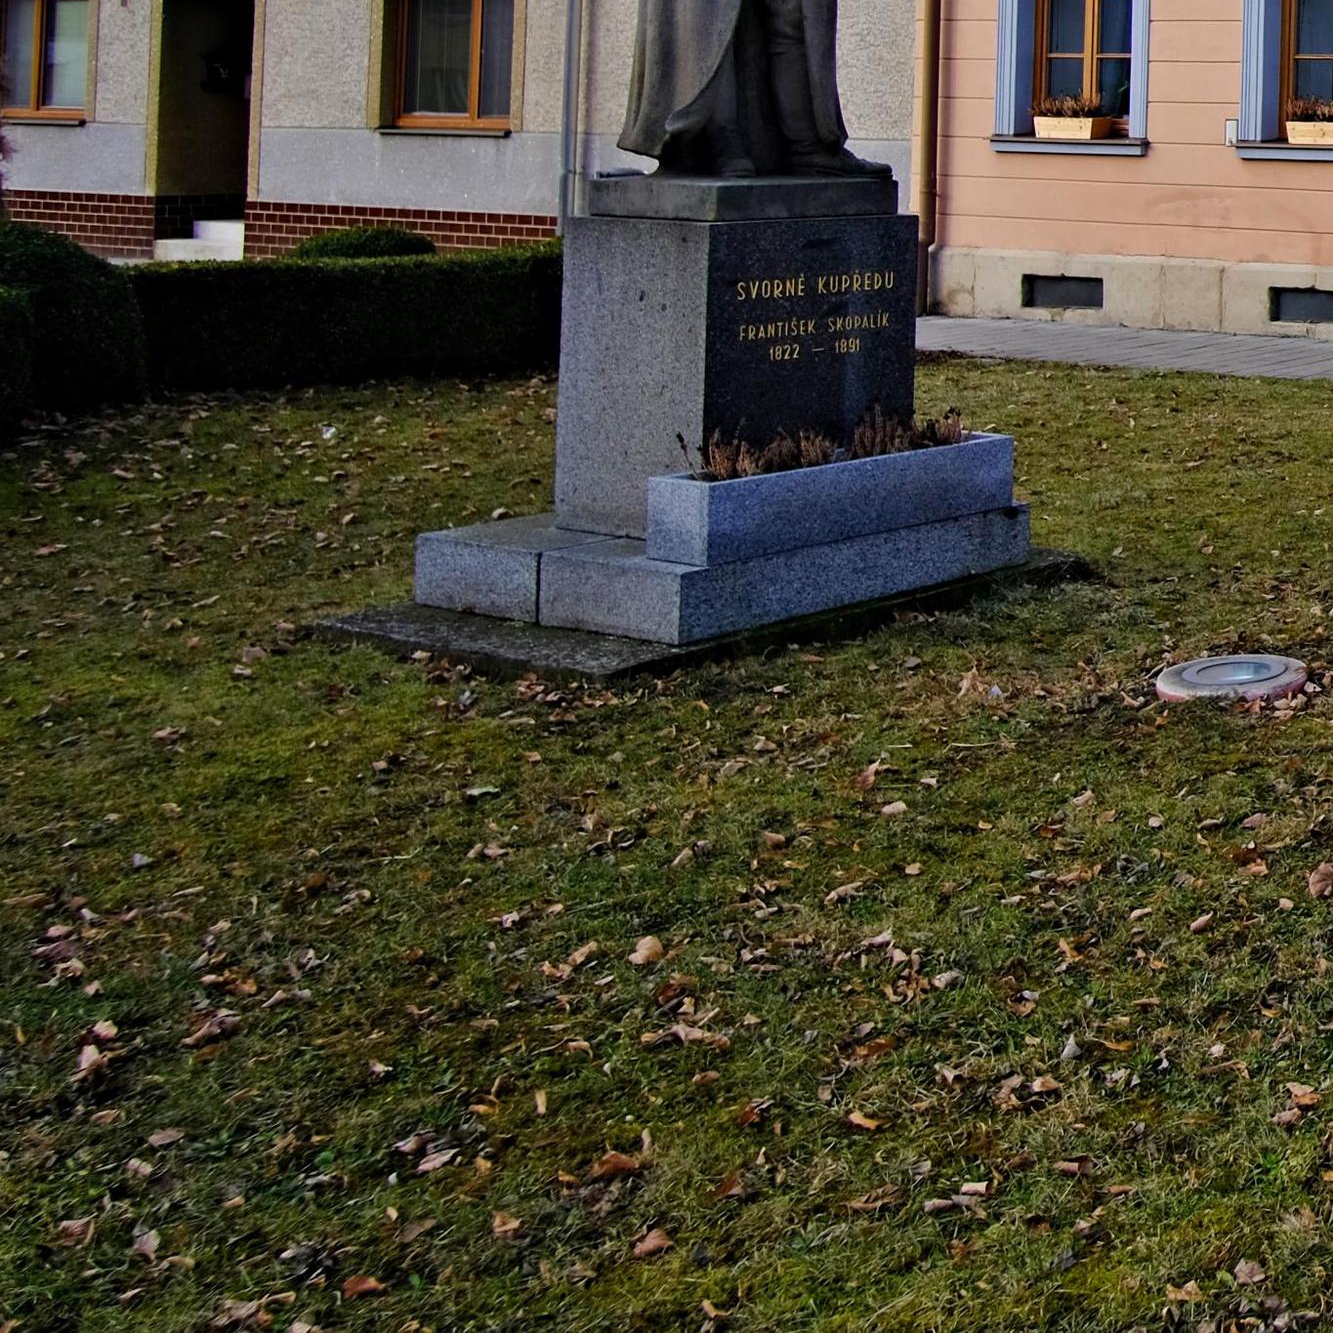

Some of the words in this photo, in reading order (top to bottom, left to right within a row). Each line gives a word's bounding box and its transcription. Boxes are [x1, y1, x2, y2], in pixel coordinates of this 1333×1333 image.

[818, 270, 895, 295] KUPŘEDU
[739, 317, 816, 341] FRANTIŠEK
[828, 309, 890, 333] SKOPALÍK
[769, 344, 800, 361] 1822
[835, 338, 861, 354] 1891
